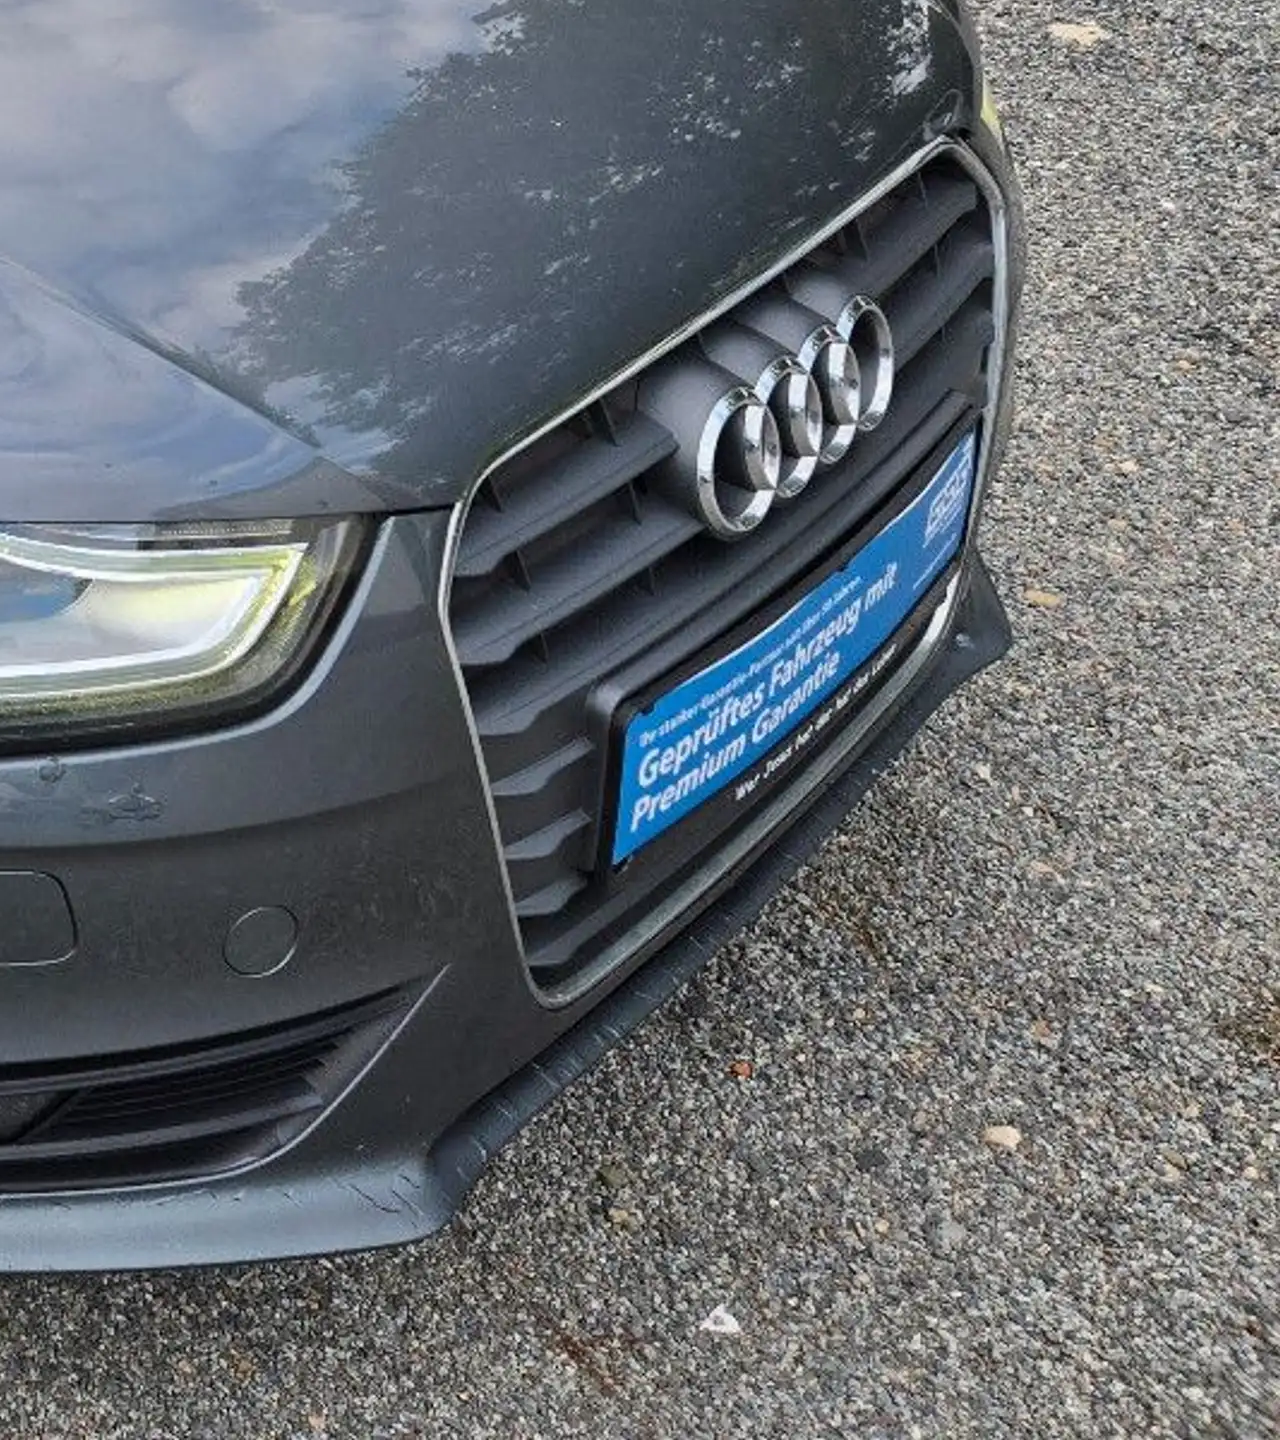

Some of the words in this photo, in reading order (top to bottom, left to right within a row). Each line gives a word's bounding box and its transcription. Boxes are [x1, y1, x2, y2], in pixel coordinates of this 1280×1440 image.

[630, 733, 746, 833] Premium
[752, 651, 840, 744] Garantie
[638, 681, 765, 788] Geprüftes
[769, 597, 862, 697] Fahrzeug
[864, 561, 898, 611] mit
